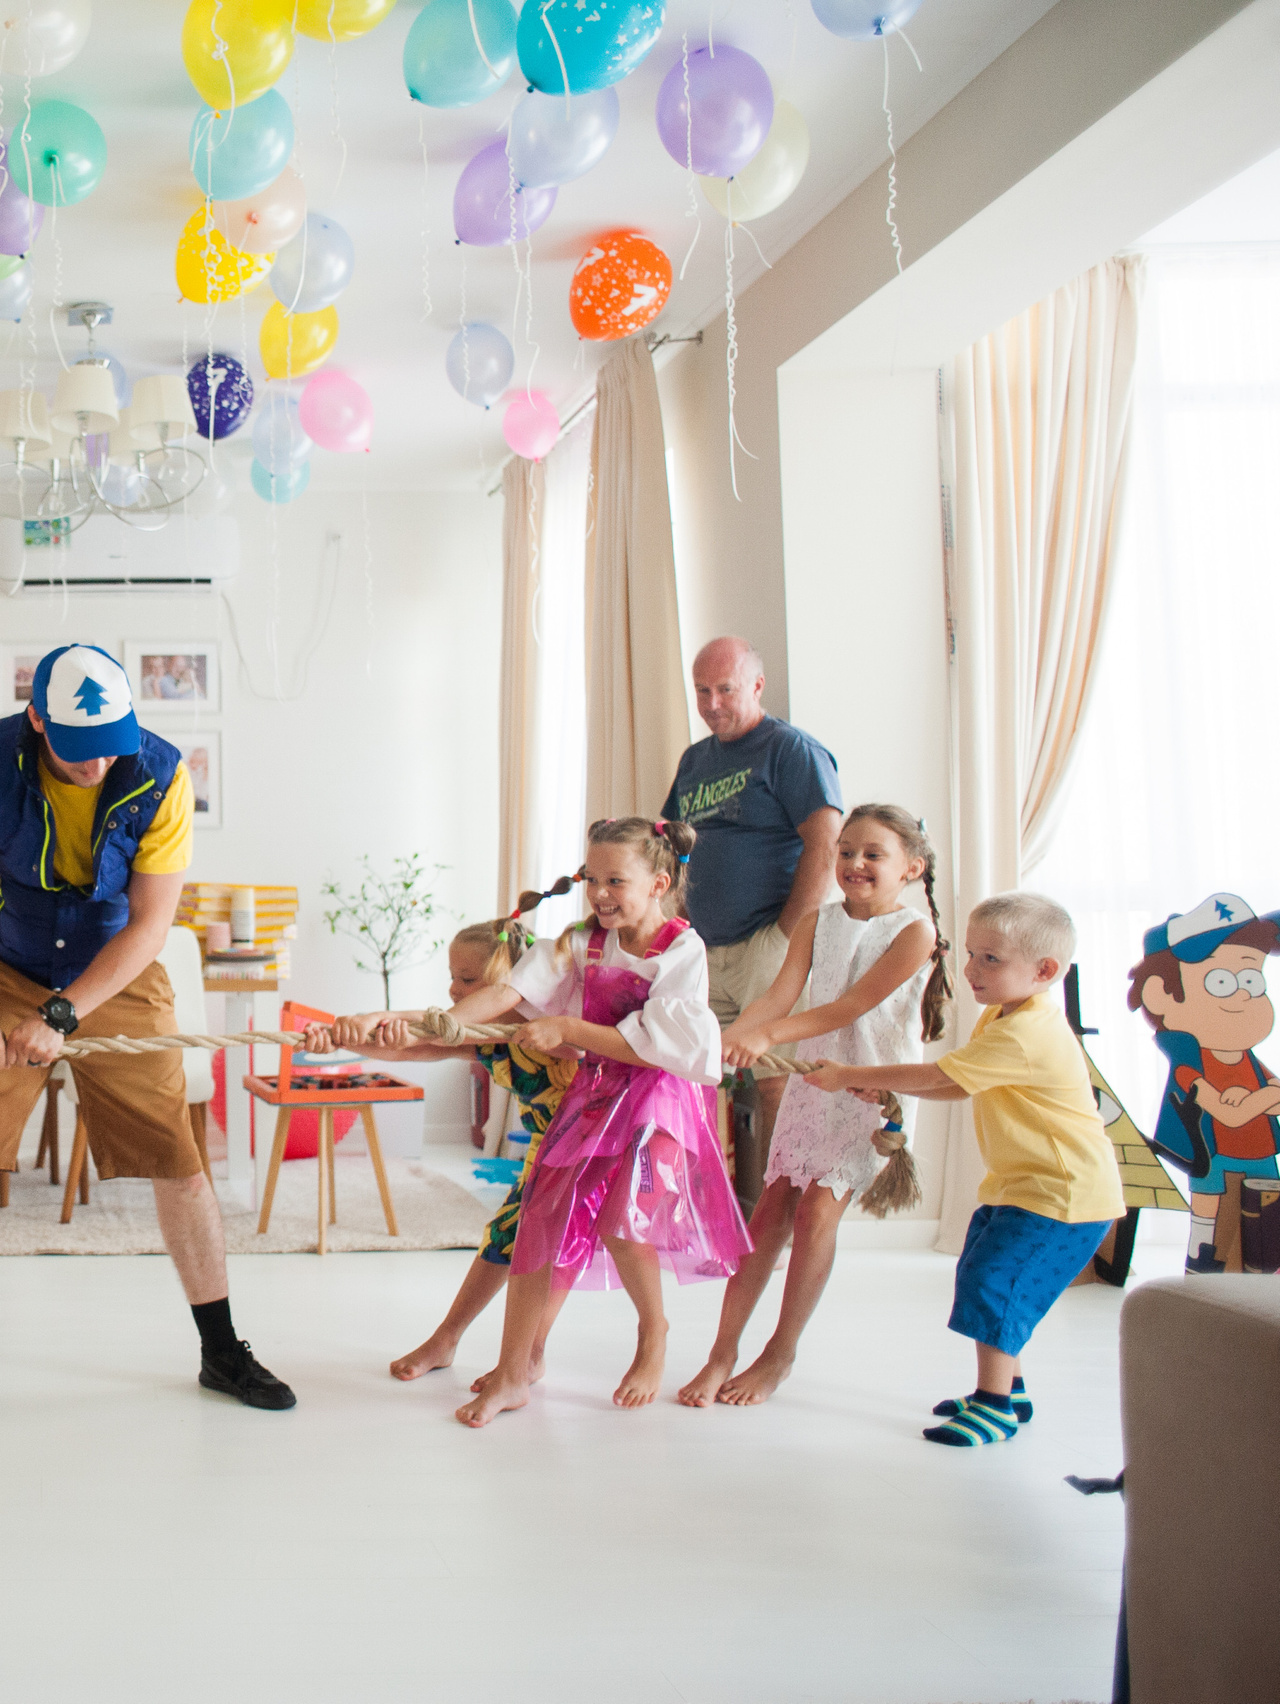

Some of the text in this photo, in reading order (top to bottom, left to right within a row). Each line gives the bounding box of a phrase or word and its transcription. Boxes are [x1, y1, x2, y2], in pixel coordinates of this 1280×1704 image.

[575, 247, 605, 276] 7
[621, 282, 658, 316] 7
[206, 367, 228, 396] 7
[690, 768, 752, 813] ANGELES
